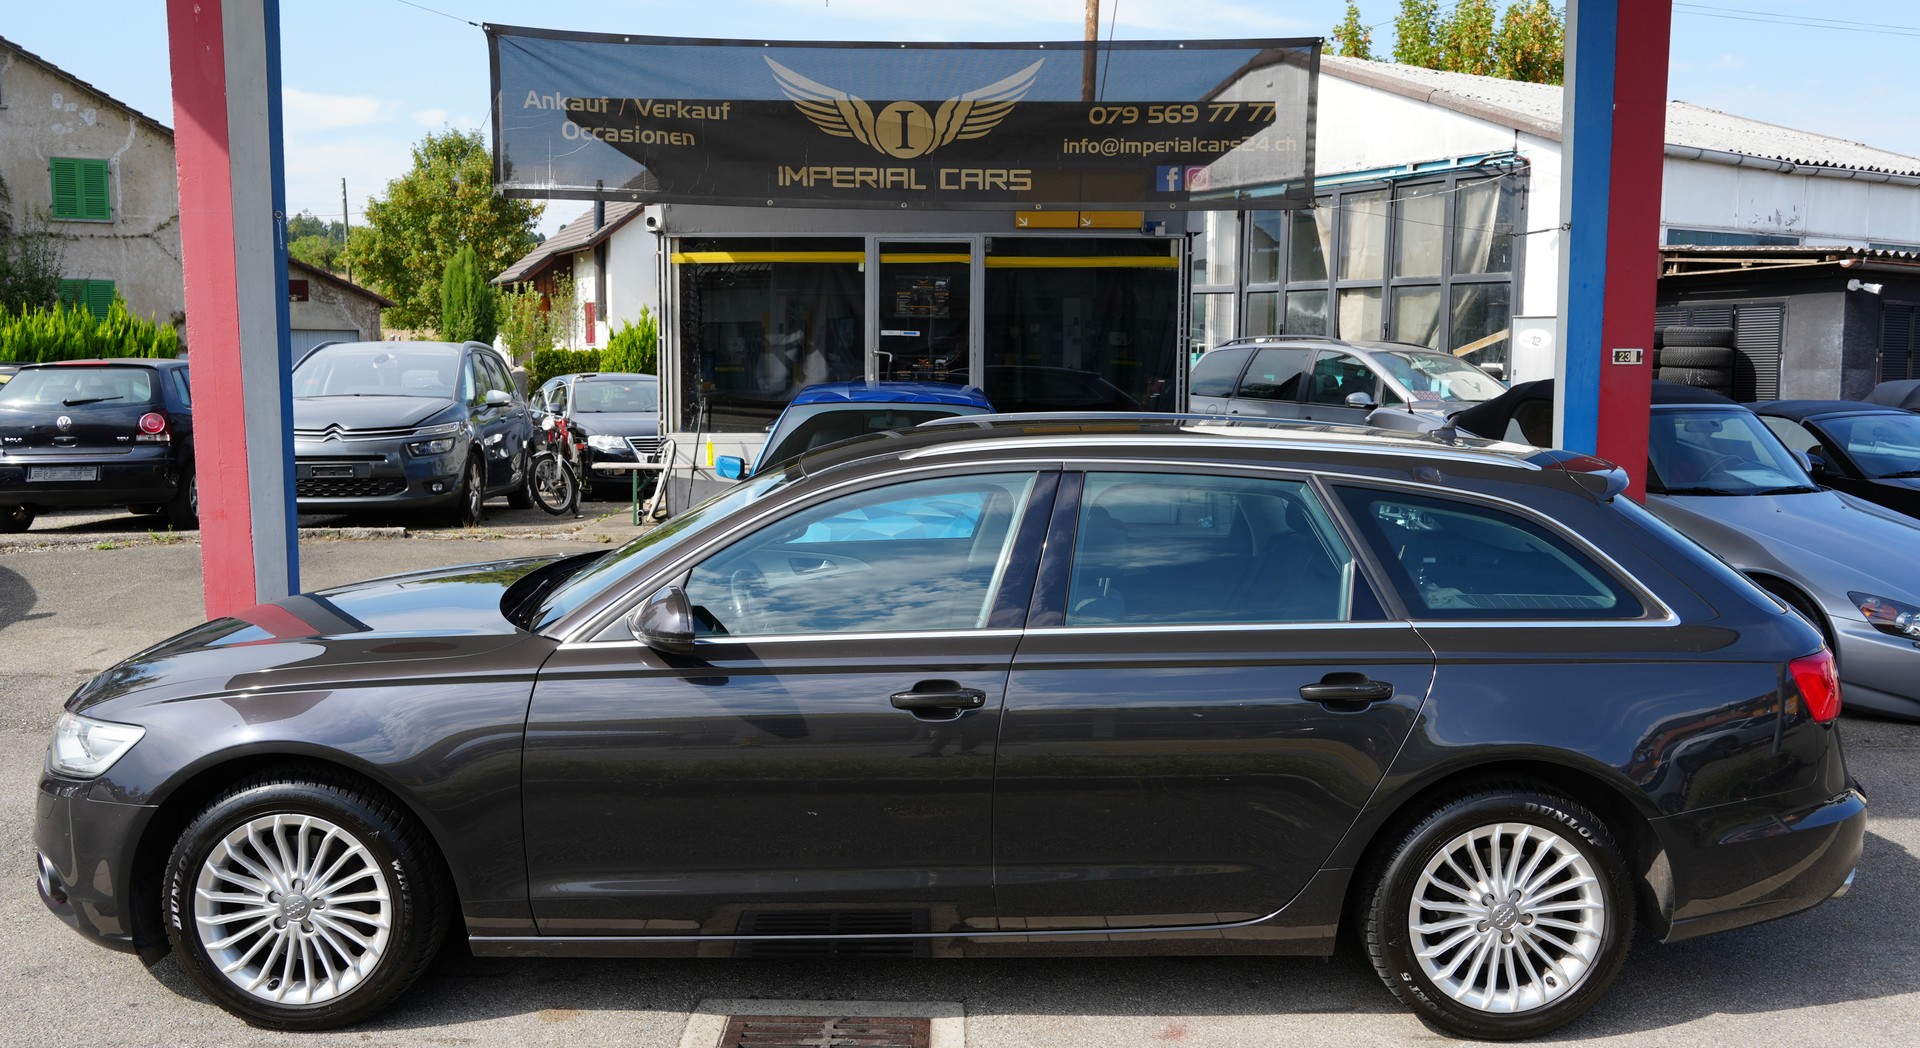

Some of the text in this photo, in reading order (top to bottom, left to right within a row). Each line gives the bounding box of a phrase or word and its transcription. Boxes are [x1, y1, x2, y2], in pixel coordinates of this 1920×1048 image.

[523, 90, 609, 113] Ankauf
[634, 98, 731, 120] Verkauf
[1088, 103, 1280, 125] 079 569 77 77
[561, 120, 695, 146] Occasionen
[1063, 136, 1297, 157] info@imperialcars24.ch
[777, 165, 1032, 190] IMPERIAL CARS
[1530, 335, 1542, 347] 12
[1618, 351, 1631, 362] 23
[1523, 801, 1604, 848] DUNLOP
[170, 842, 195, 930] DUNLOP
